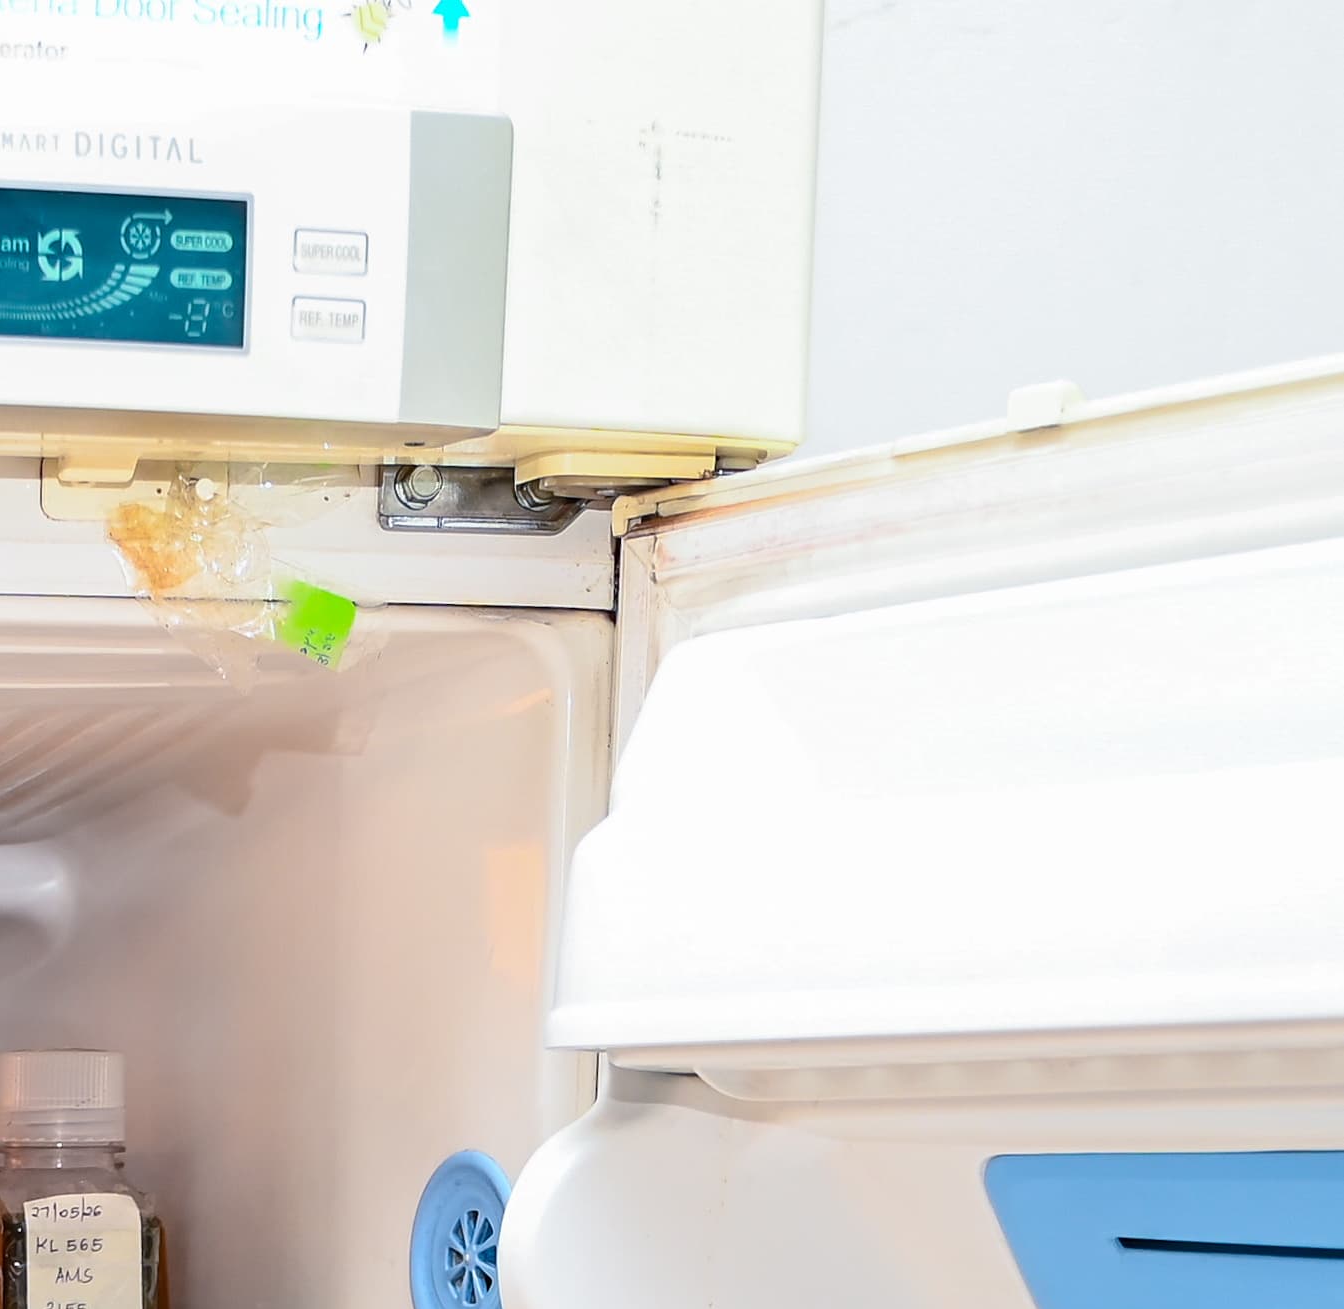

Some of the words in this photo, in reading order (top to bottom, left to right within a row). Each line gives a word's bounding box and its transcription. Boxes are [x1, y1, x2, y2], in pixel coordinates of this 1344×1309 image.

[95, 0, 179, 22] Door
[192, 0, 324, 41] Sealing
[74, 132, 204, 164] DIGITAL
[175, 235, 203, 248] SUPER
[205, 236, 230, 249] COOL
[300, 244, 334, 260] SUPER
[334, 246, 361, 262] COOL
[201, 274, 227, 287] TEMP
[328, 312, 359, 329] TEMP
[32, 1203, 103, 1226] 27/05/26
[35, 1236, 61, 1254] KL
[66, 1236, 103, 1252] 565
[56, 1268, 94, 1285] AMS
